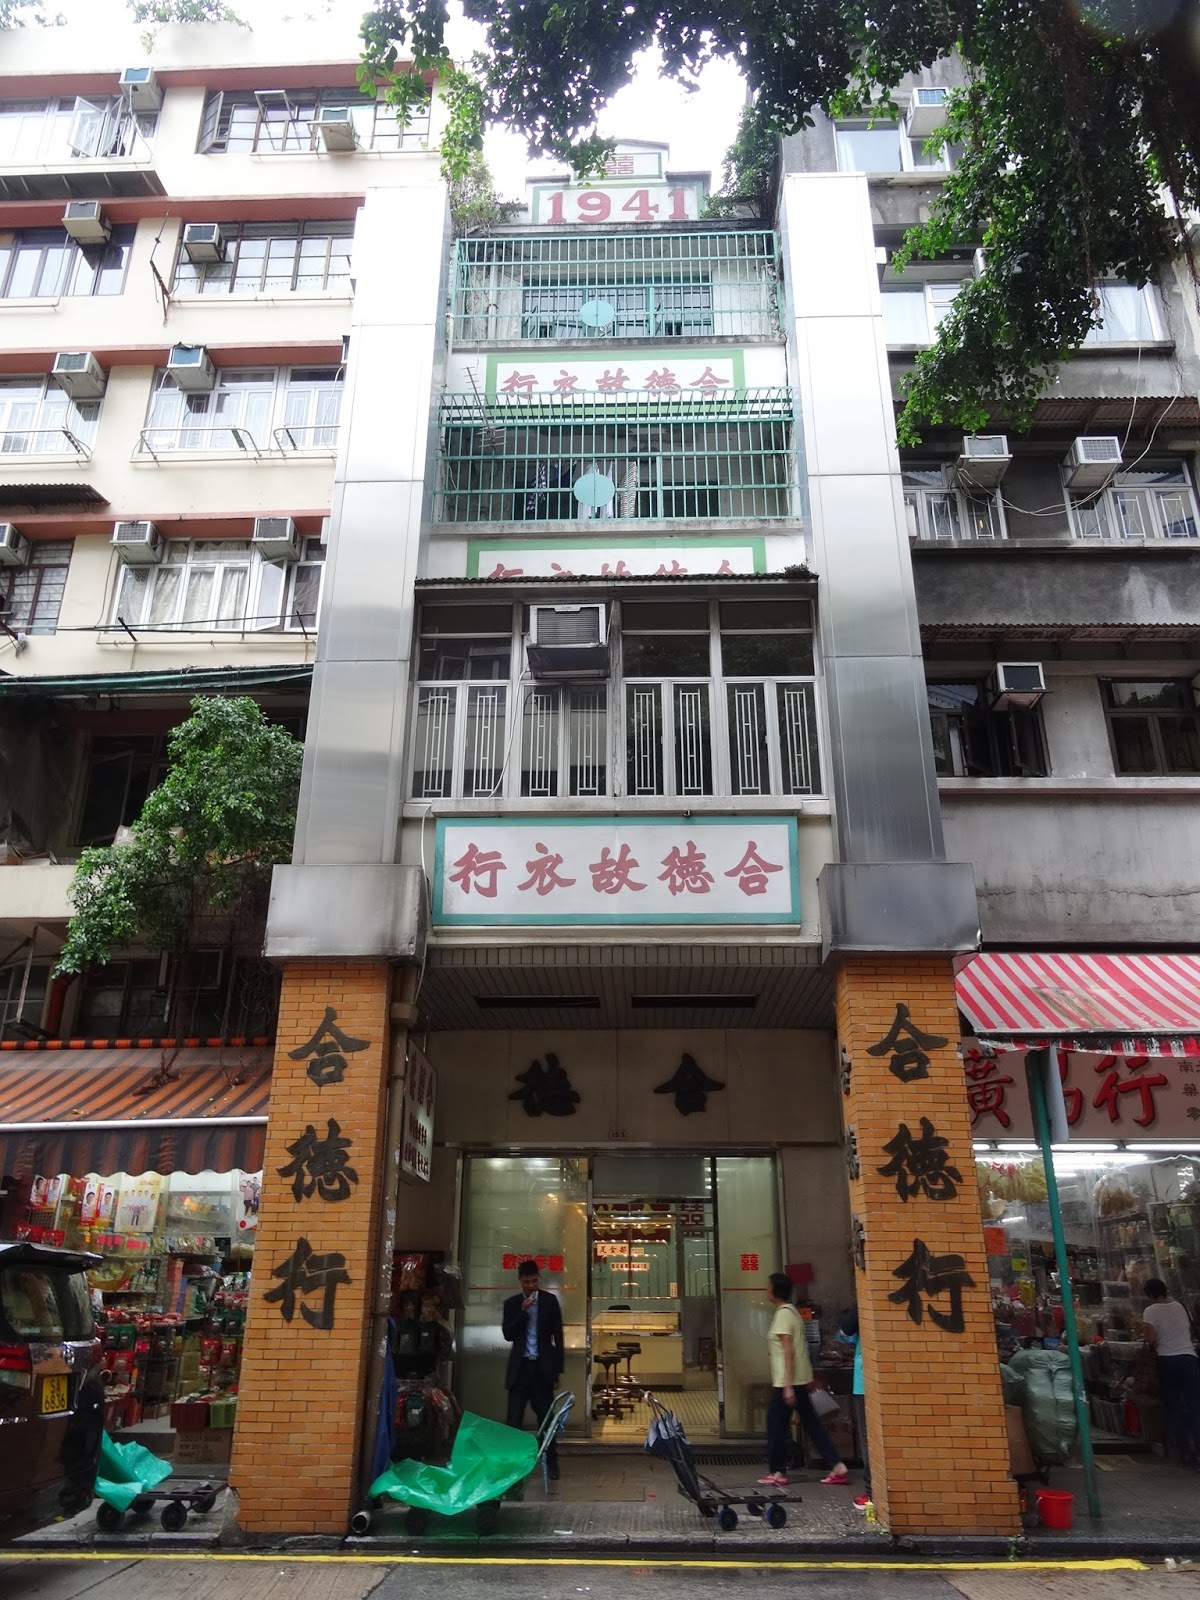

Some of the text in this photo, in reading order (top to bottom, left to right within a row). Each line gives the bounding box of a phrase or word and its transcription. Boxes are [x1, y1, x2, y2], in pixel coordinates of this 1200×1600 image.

[547, 187, 690, 224] 1941
[49, 1378, 61, 1395] SA
[44, 1393, 66, 1411] 6836
